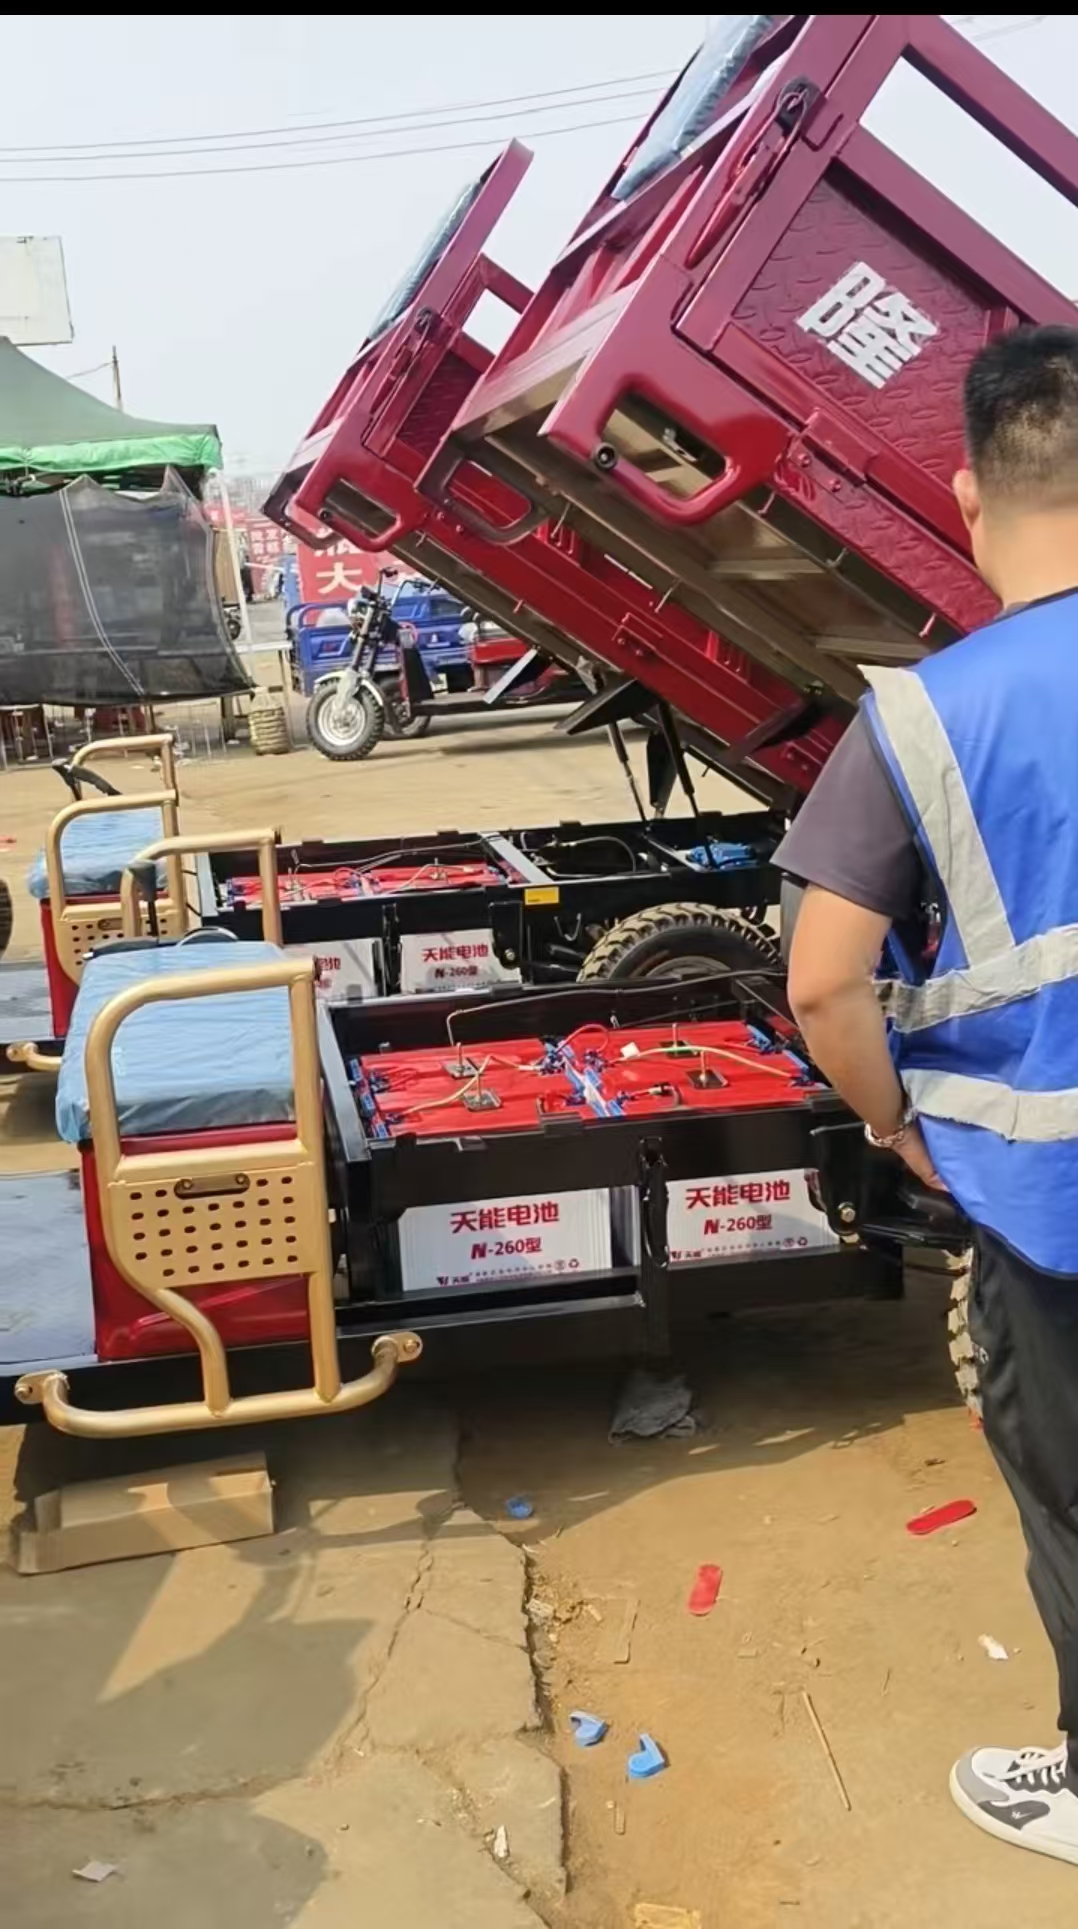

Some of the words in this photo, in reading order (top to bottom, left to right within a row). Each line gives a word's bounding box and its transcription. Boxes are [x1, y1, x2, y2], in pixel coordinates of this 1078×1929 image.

[796, 261, 939, 389] 隆
[423, 943, 488, 962] 天能电池
[685, 1179, 790, 1209] 天能电池
[450, 1201, 560, 1234] 天能电池
[703, 1214, 773, 1235] N-260型
[470, 1237, 541, 1260] N-260型
